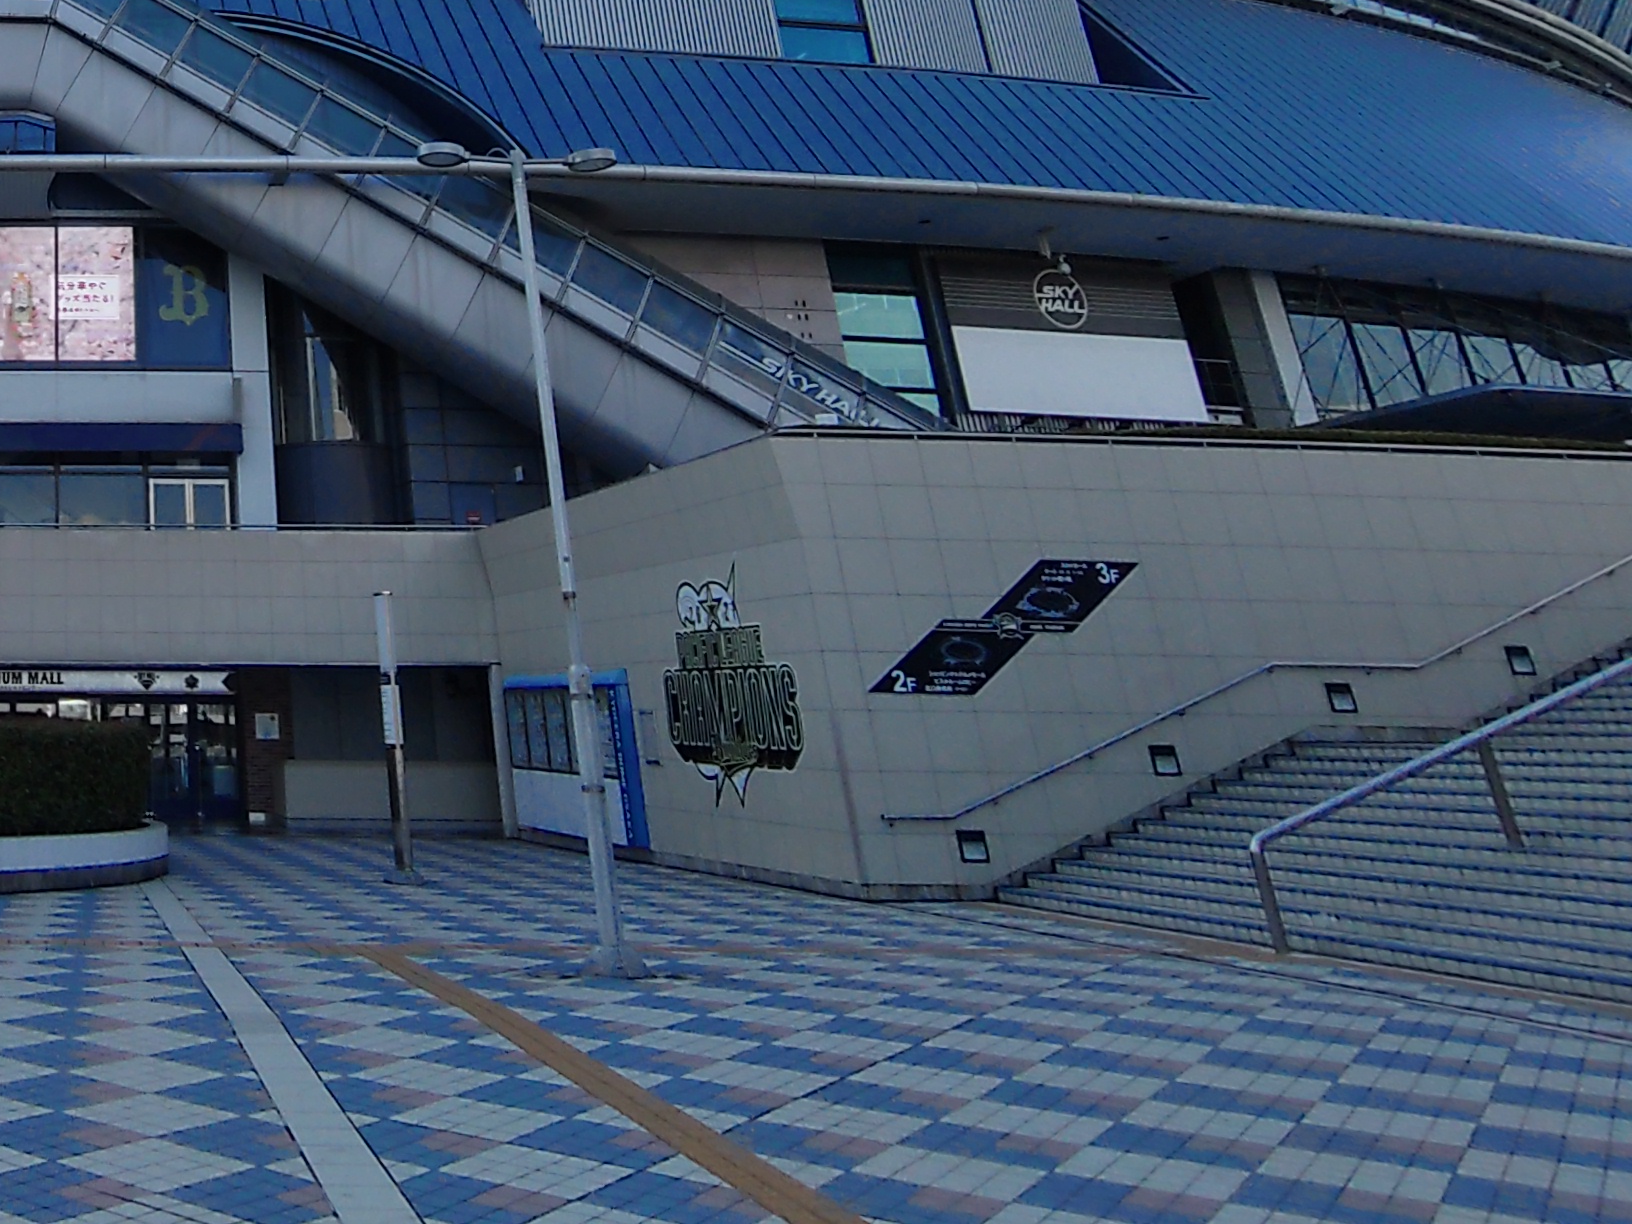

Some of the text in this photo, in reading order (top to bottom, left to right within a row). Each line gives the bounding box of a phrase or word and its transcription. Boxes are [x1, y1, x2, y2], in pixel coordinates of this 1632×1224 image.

[158, 264, 210, 326] B
[1041, 284, 1079, 299] SKY
[1040, 298, 1086, 314] HALL
[761, 357, 819, 394] SKY
[1095, 562, 1120, 584] 3F
[27, 671, 65, 686] MALL
[891, 670, 917, 692] 2F
[664, 664, 805, 752] CHAMPIONS
